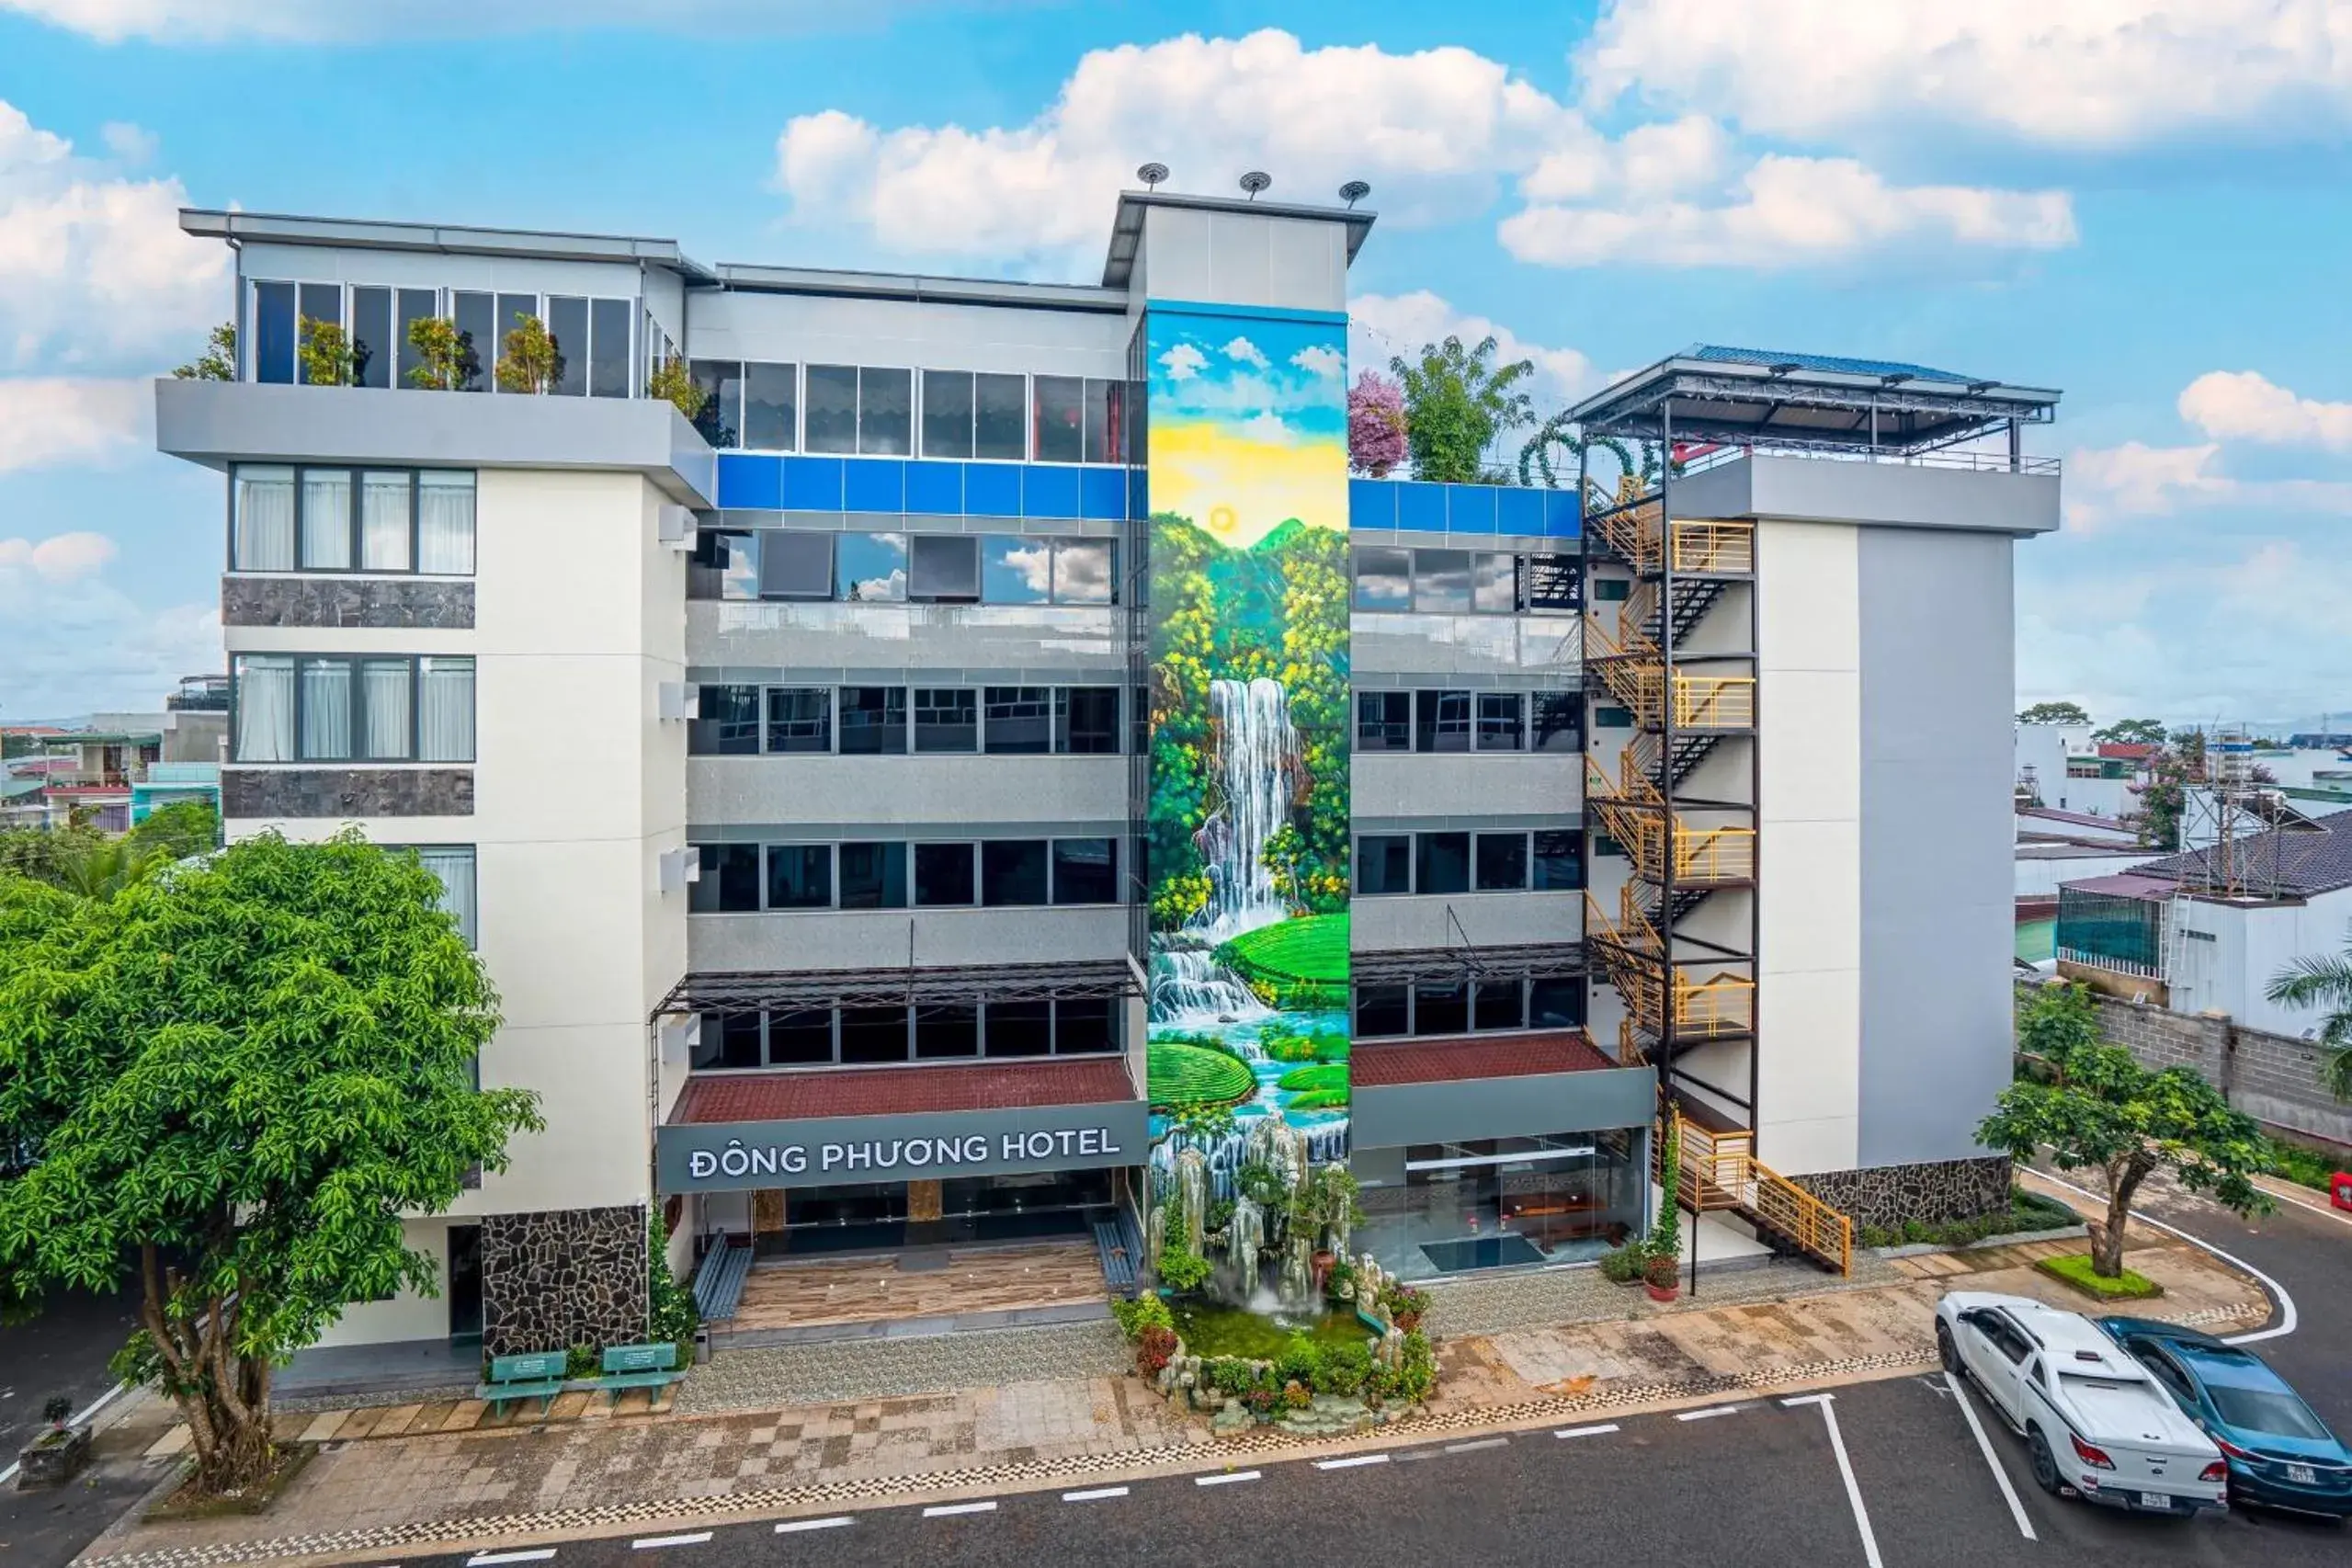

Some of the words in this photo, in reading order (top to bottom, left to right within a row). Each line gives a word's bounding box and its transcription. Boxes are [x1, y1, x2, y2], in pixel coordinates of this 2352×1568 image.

[689, 1140, 806, 1177] ĐÔNG
[822, 1136, 988, 1170] PHƯƠNG
[1003, 1129, 1120, 1159] HOTEL
